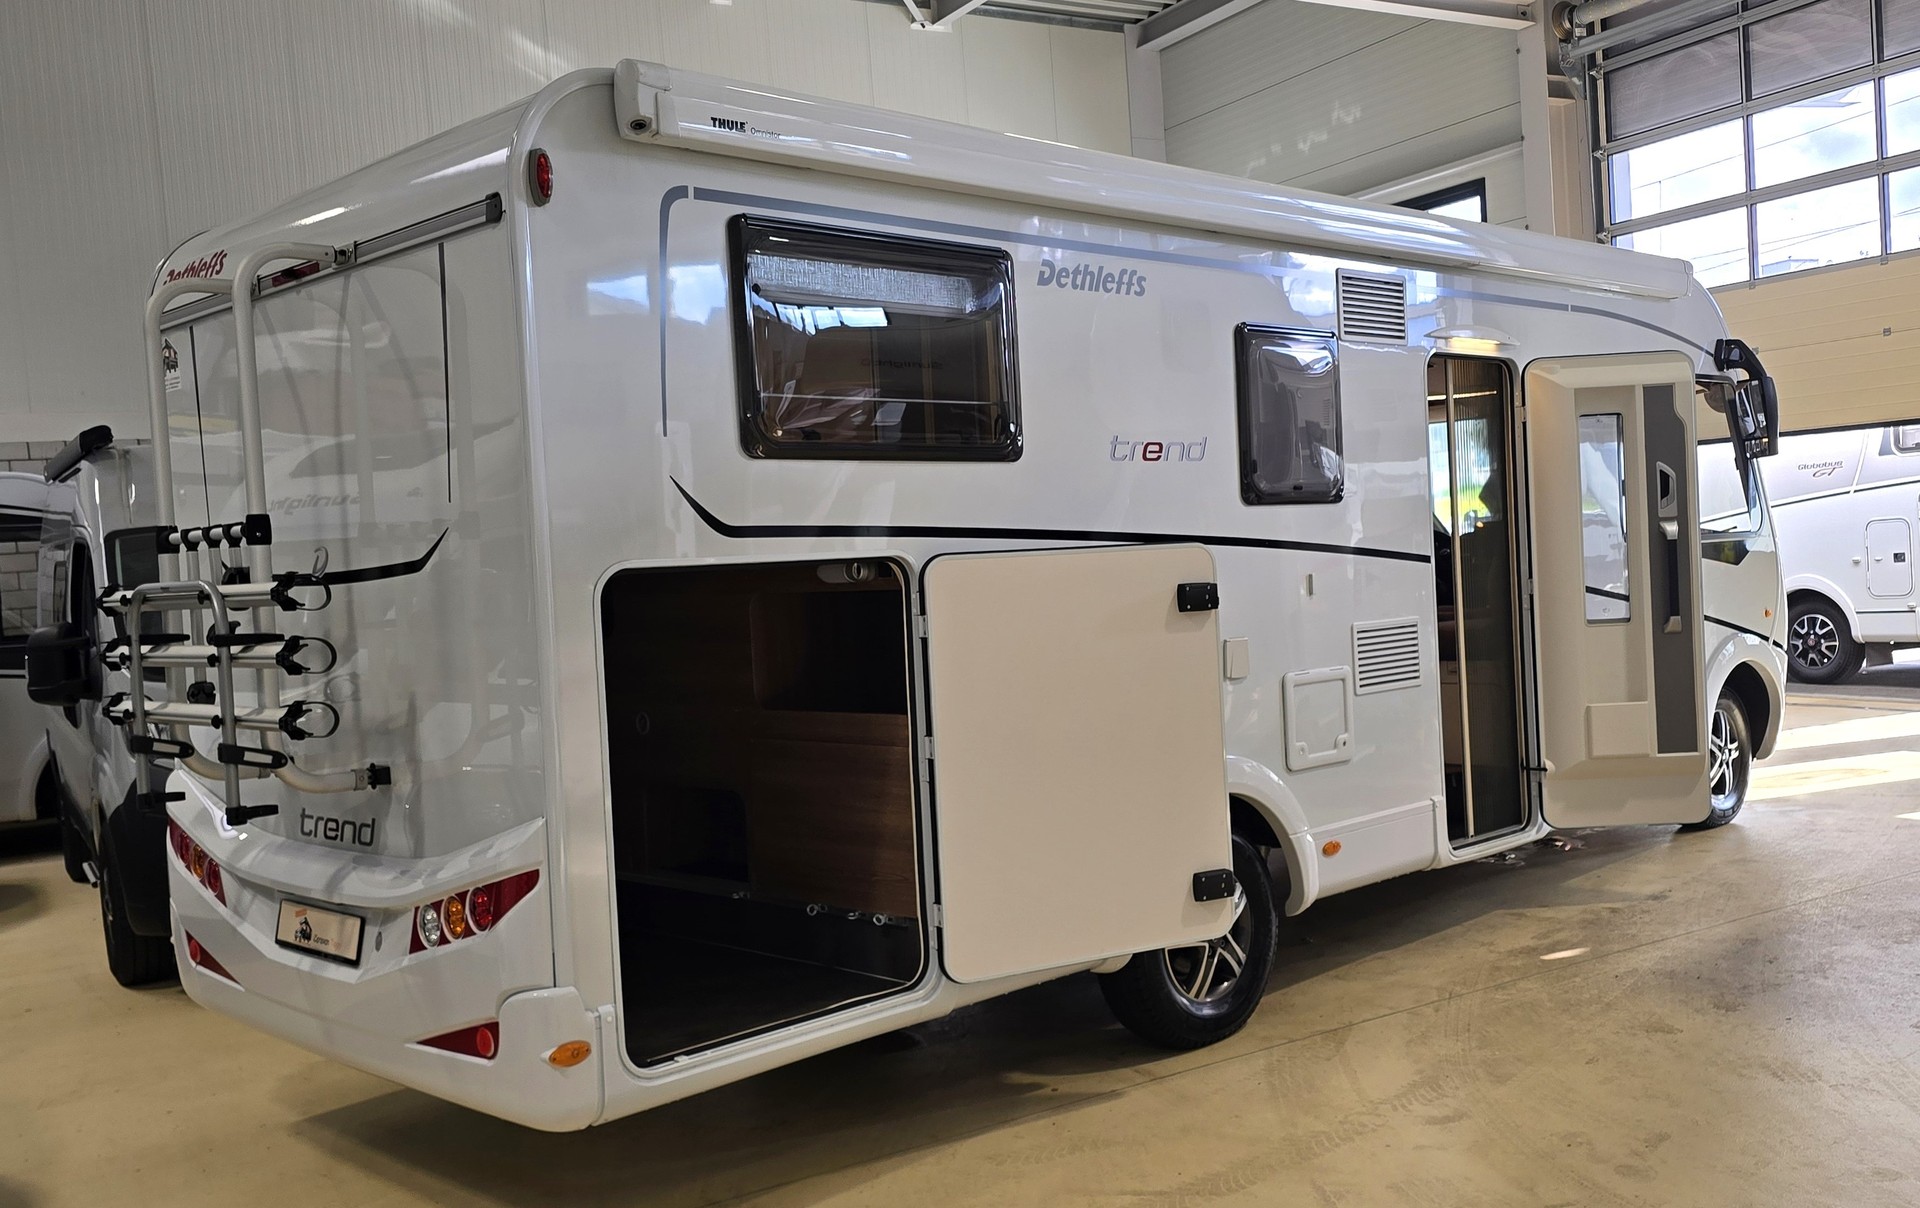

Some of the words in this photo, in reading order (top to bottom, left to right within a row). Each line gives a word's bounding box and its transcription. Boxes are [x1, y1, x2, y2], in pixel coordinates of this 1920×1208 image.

[710, 116, 747, 134] THULE
[1037, 258, 1147, 297] Dethleffs
[1110, 435, 1207, 462] trend
[300, 807, 376, 847] trend
